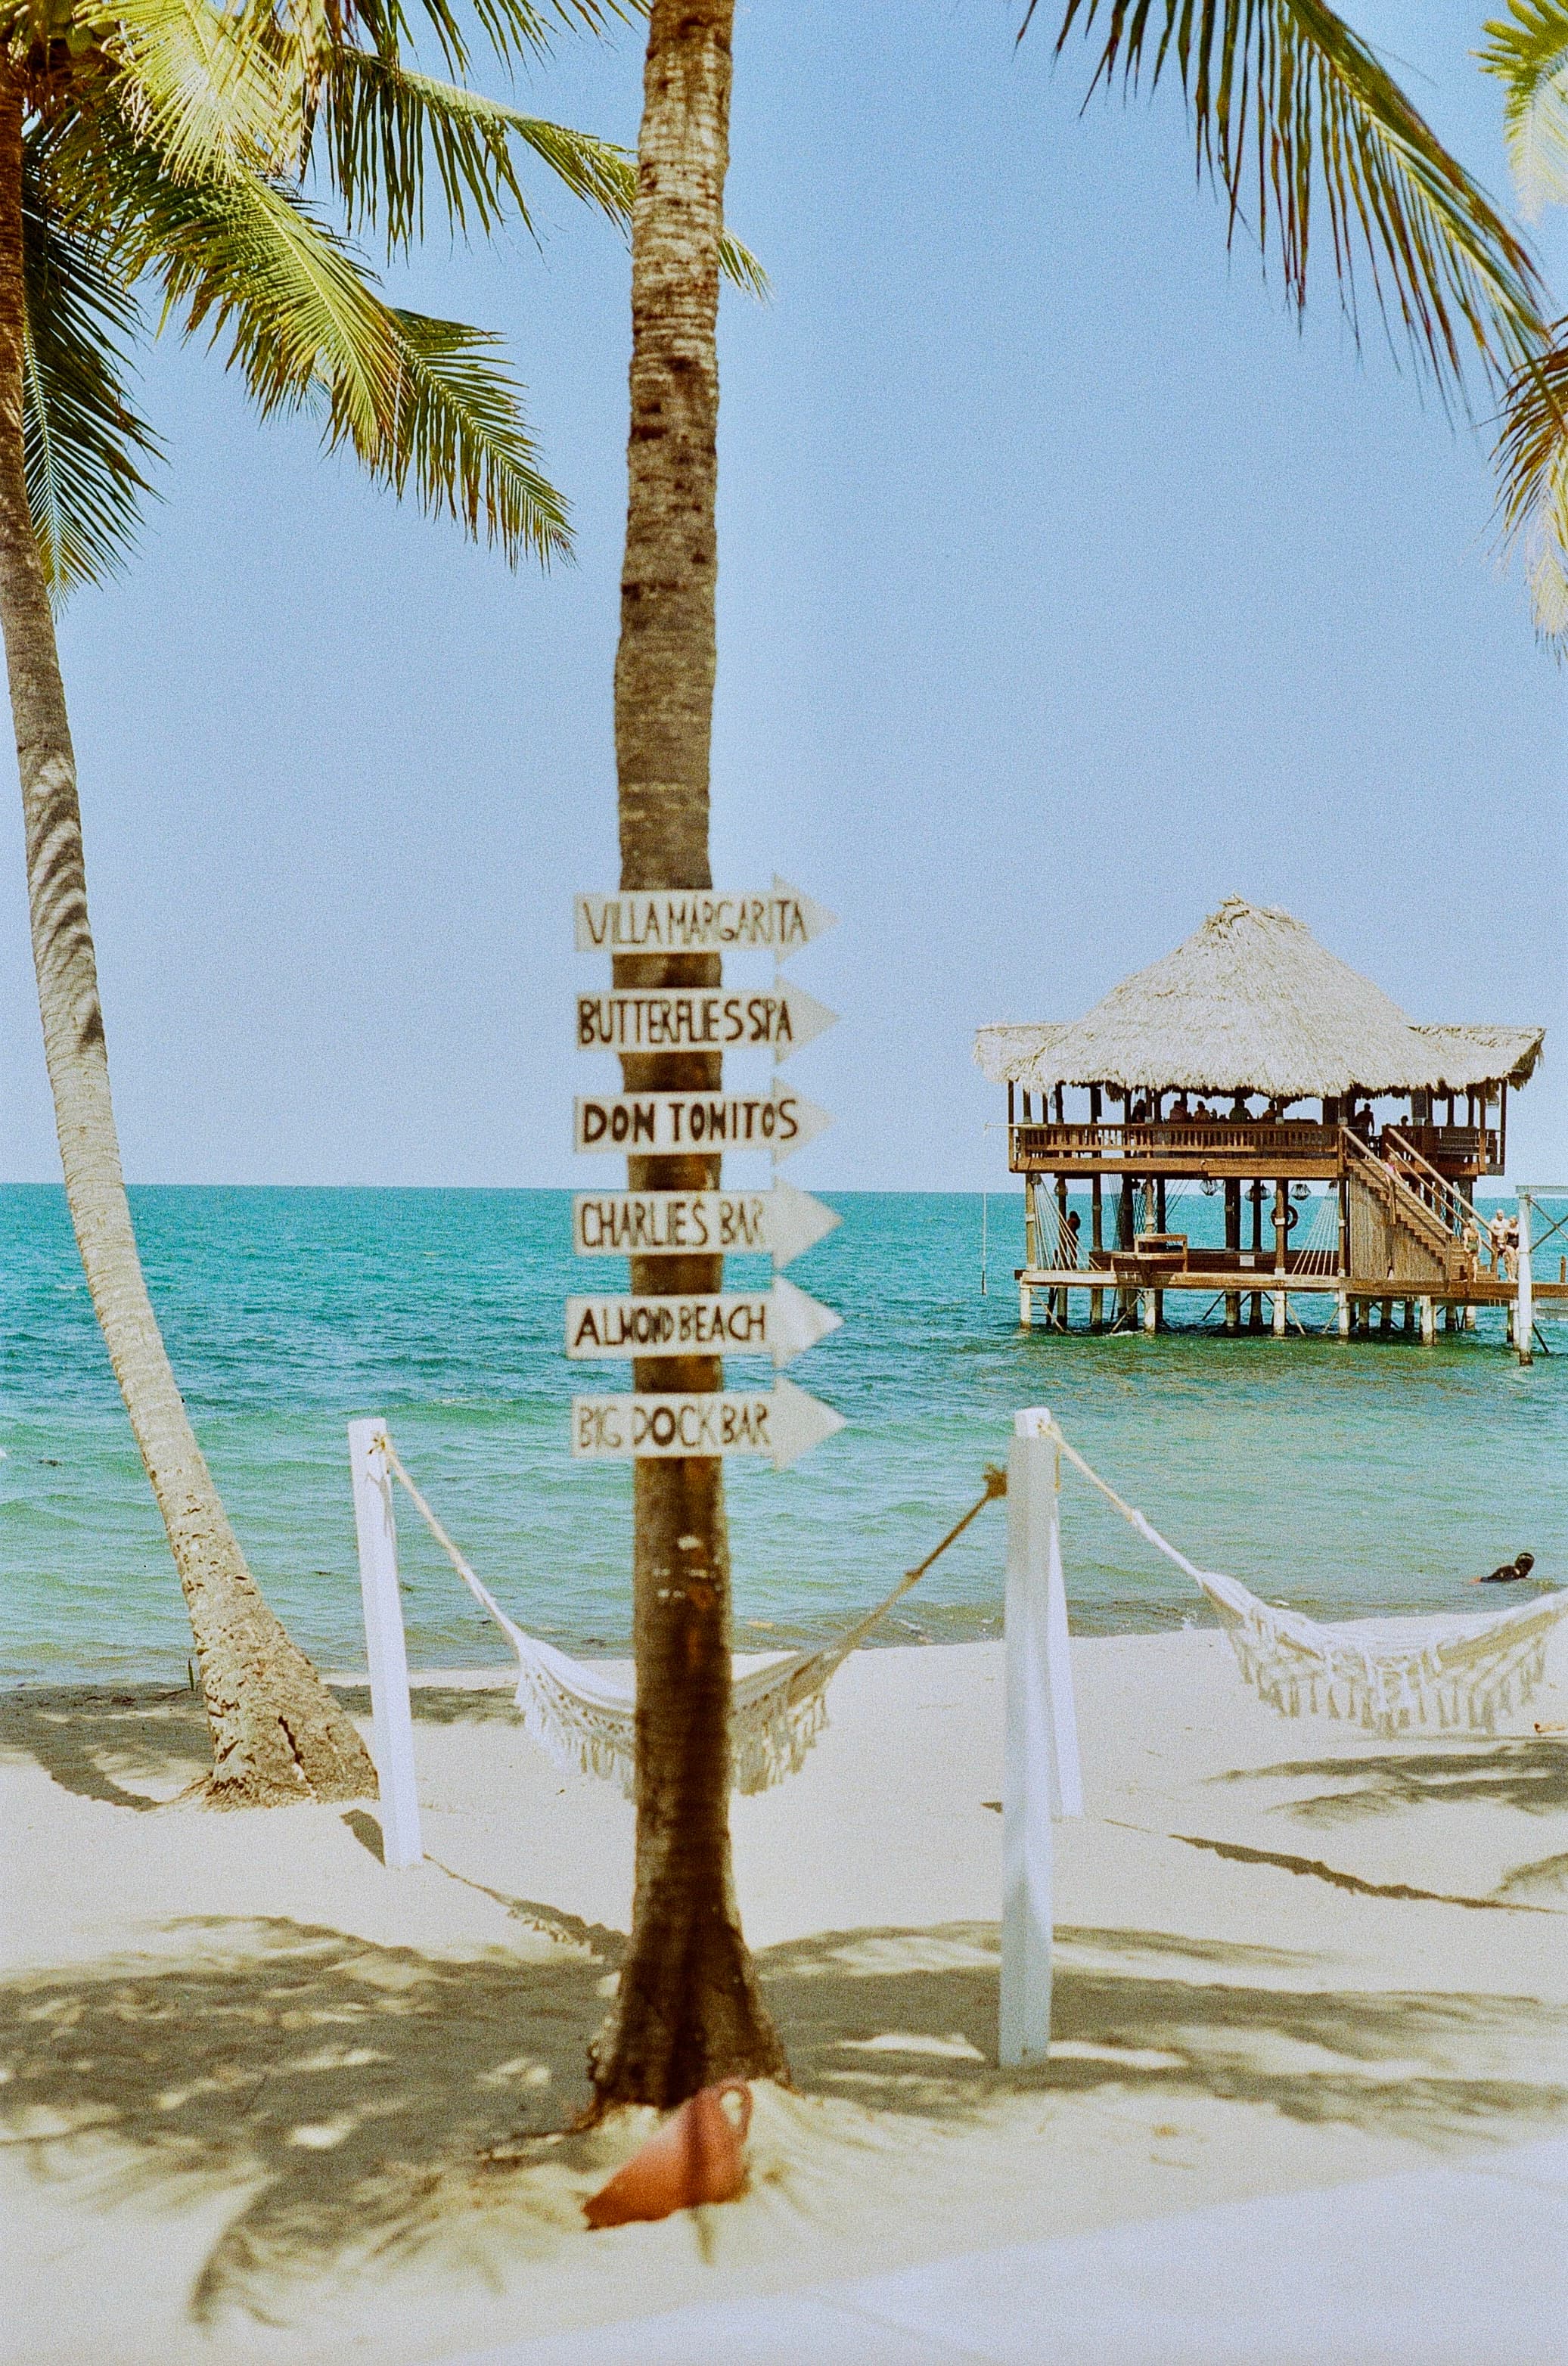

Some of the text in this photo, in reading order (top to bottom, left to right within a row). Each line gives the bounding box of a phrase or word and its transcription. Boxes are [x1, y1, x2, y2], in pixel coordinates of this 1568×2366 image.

[582, 900, 663, 945] VILLA
[583, 1099, 799, 1143] DON TONITOS
[719, 1198, 766, 1246] BAR
[678, 1303, 765, 1343] BEACH
[579, 1402, 772, 1448] BIG DOCK BAR
